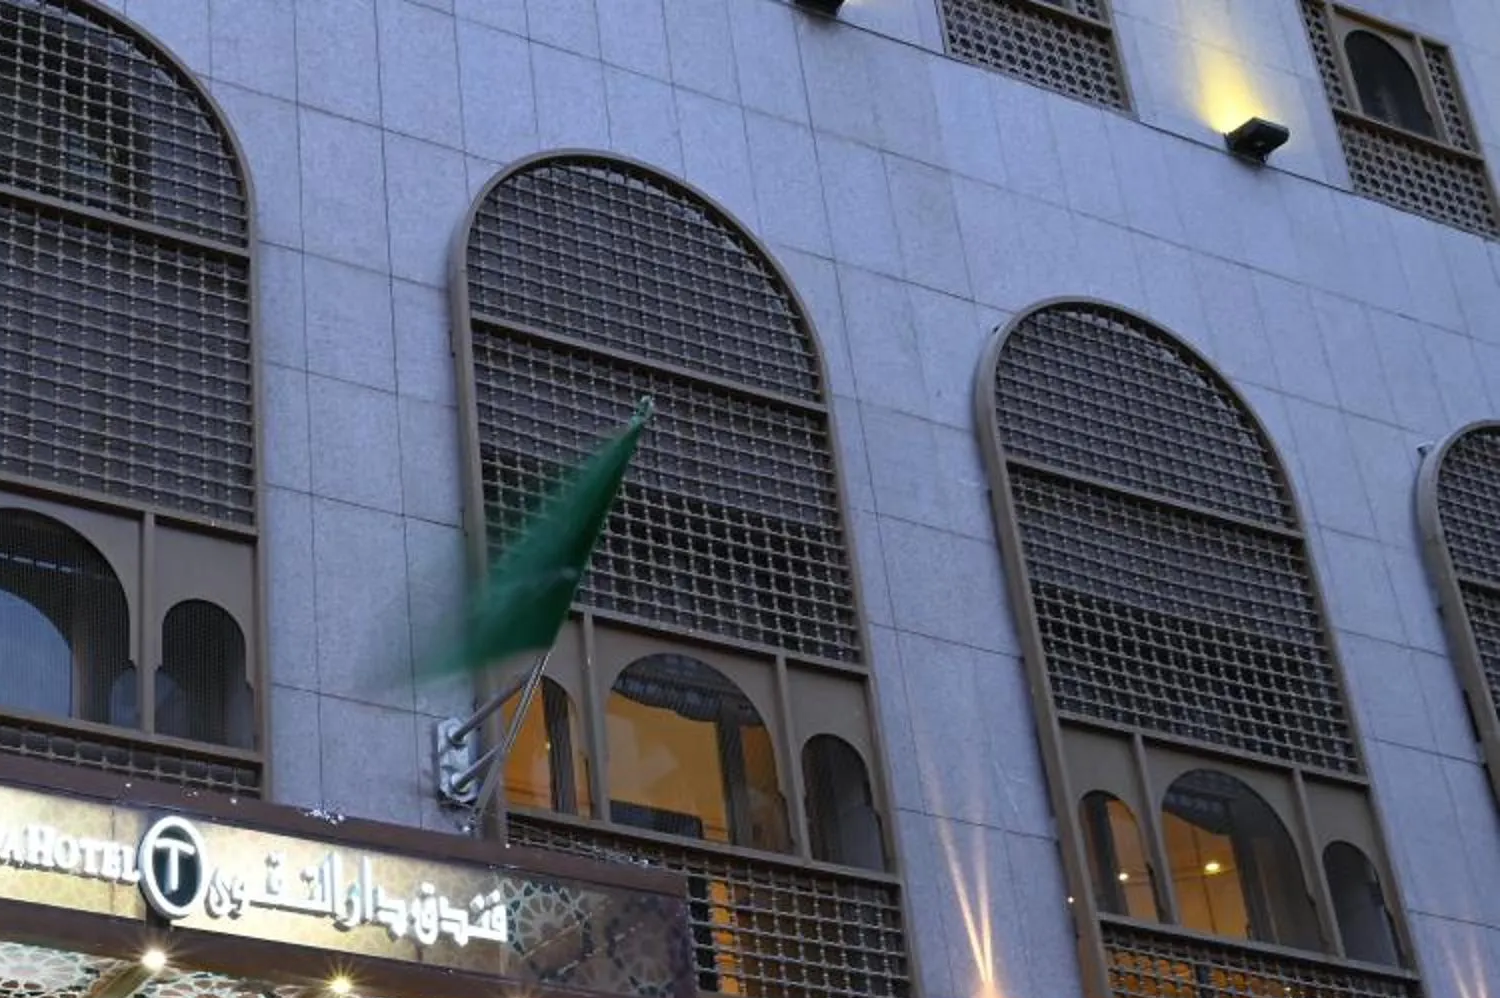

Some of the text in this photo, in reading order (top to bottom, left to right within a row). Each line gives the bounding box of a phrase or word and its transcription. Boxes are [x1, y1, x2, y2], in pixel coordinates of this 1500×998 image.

[23, 823, 140, 882] HOTEL
[339, 855, 407, 937] دار
[412, 881, 507, 946] فندق
